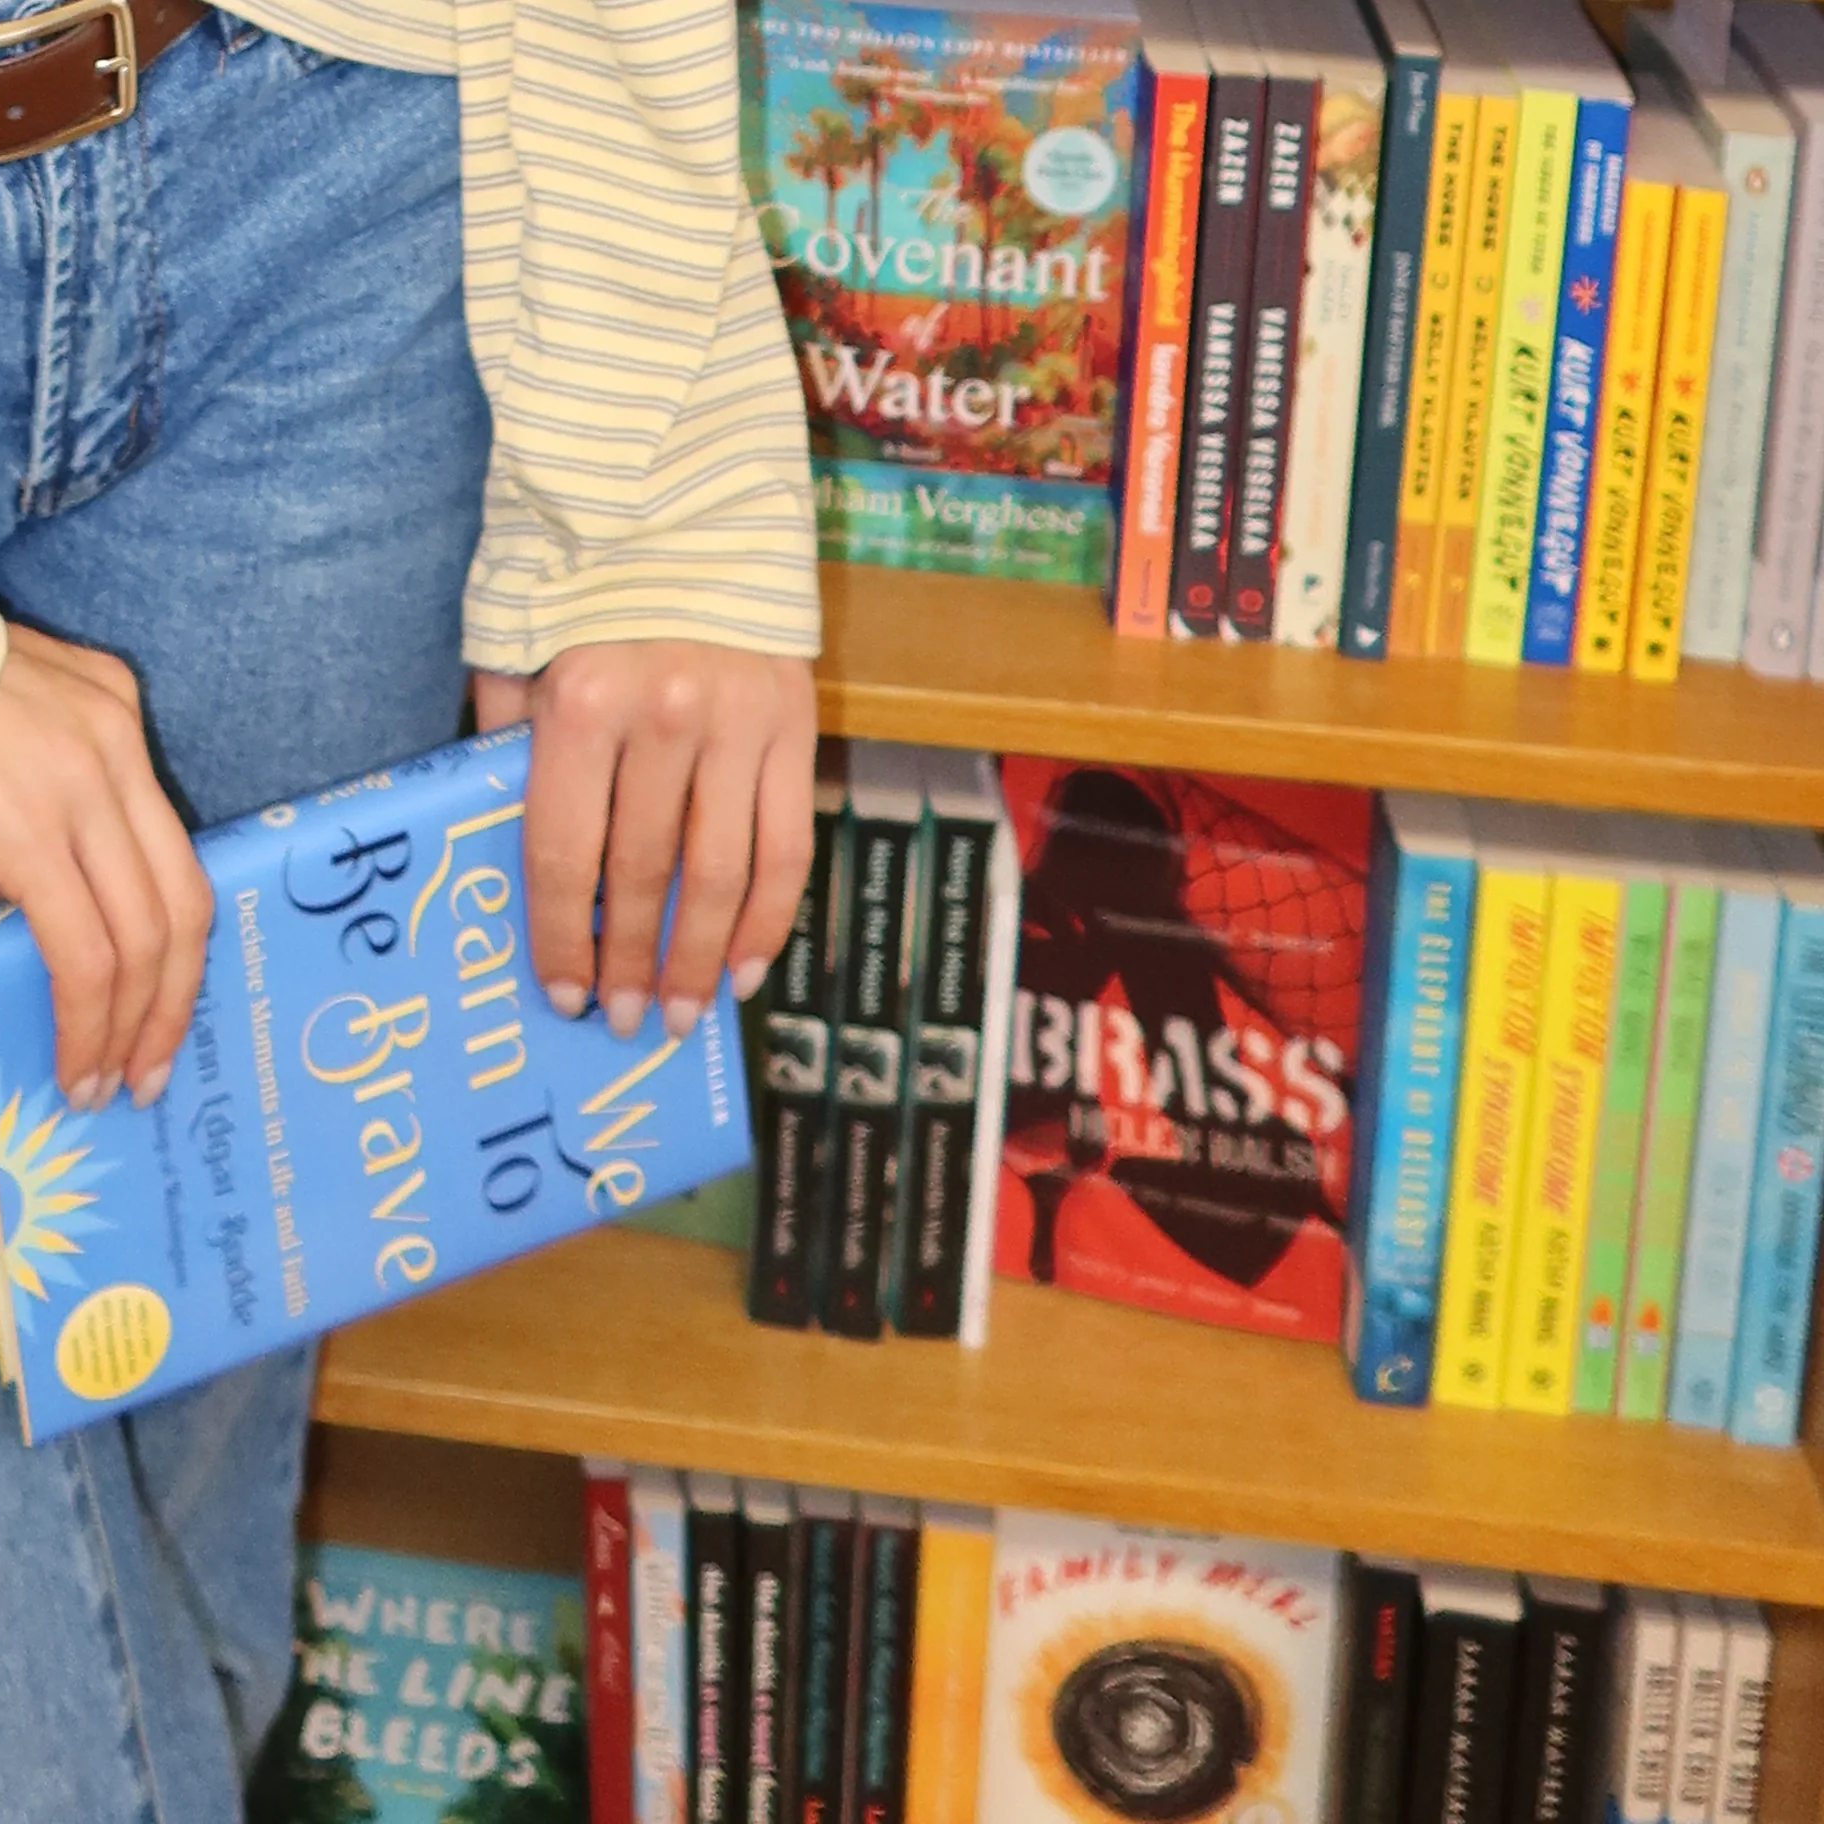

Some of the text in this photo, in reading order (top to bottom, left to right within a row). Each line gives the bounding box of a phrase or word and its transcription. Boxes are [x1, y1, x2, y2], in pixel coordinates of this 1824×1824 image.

[805, 342, 1032, 429] Water
[916, 484, 1086, 534] Verghese
[1539, 337, 1593, 595] KURT VONNEGUT
[236, 887, 263, 992] Decisive
[250, 997, 279, 1114] Moments
[281, 827, 437, 1291] Be Brave
[1009, 990, 1348, 1134] BRASS
[581, 1034, 683, 1213] We
[268, 1152, 294, 1196] Life
[275, 1204, 304, 1250] and
[283, 1254, 310, 1319] Faith
[306, 1578, 537, 1656] WHERE
[399, 1657, 575, 1724] LINE
[300, 1698, 540, 1788] BLEEDS
